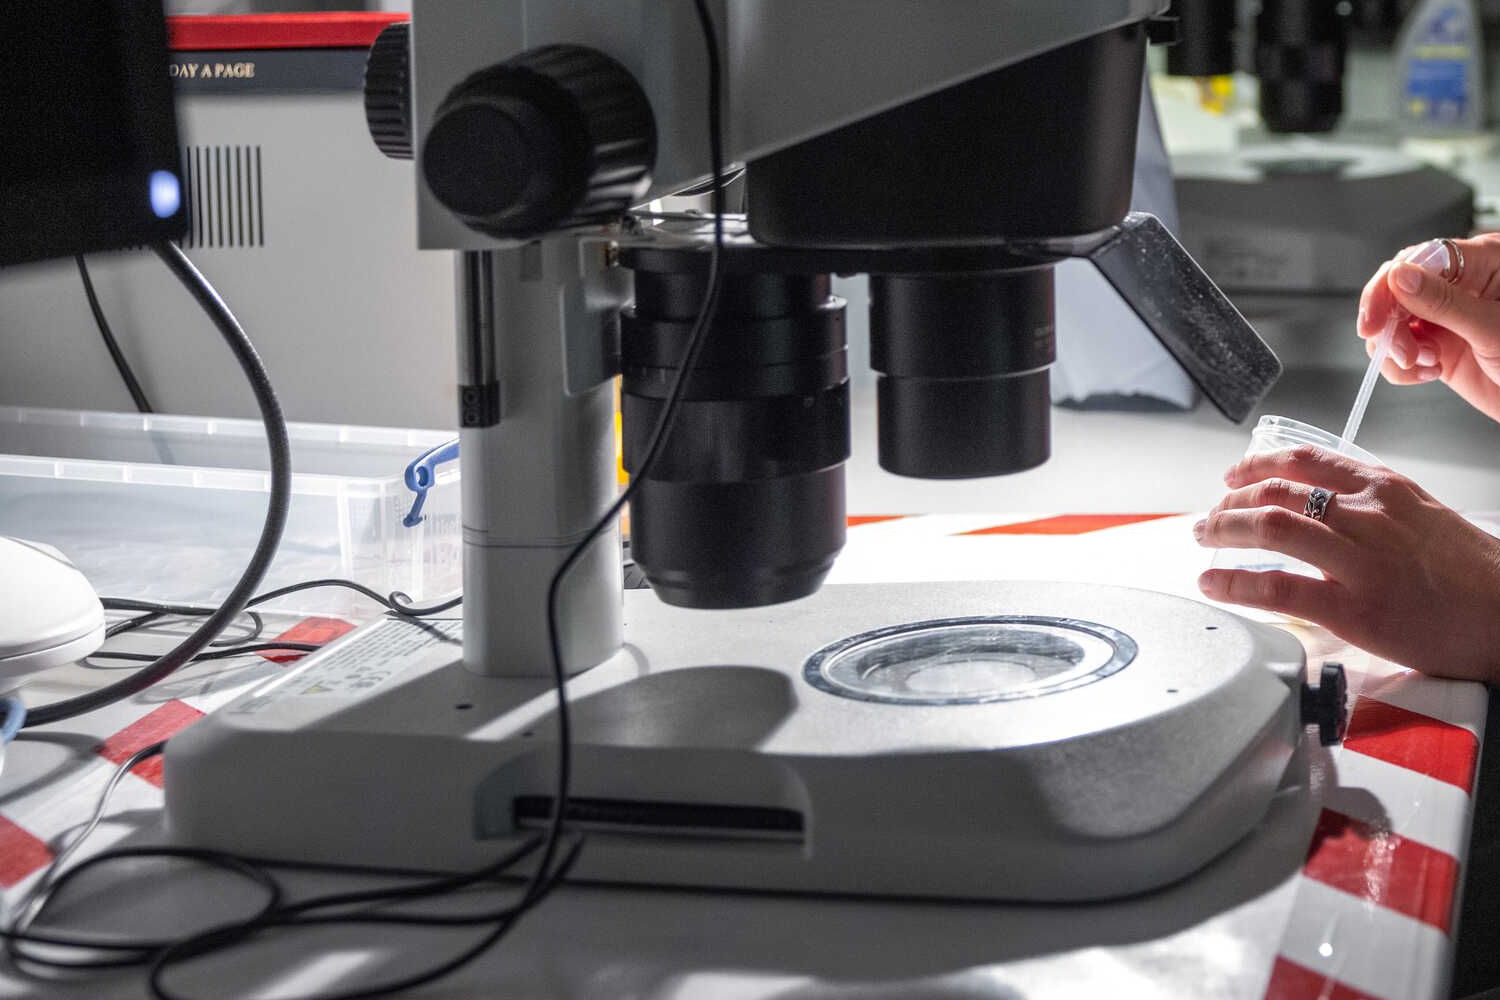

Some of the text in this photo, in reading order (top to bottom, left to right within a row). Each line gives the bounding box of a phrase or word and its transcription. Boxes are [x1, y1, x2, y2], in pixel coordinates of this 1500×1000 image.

[169, 62, 255, 78] DAY A PAGE
